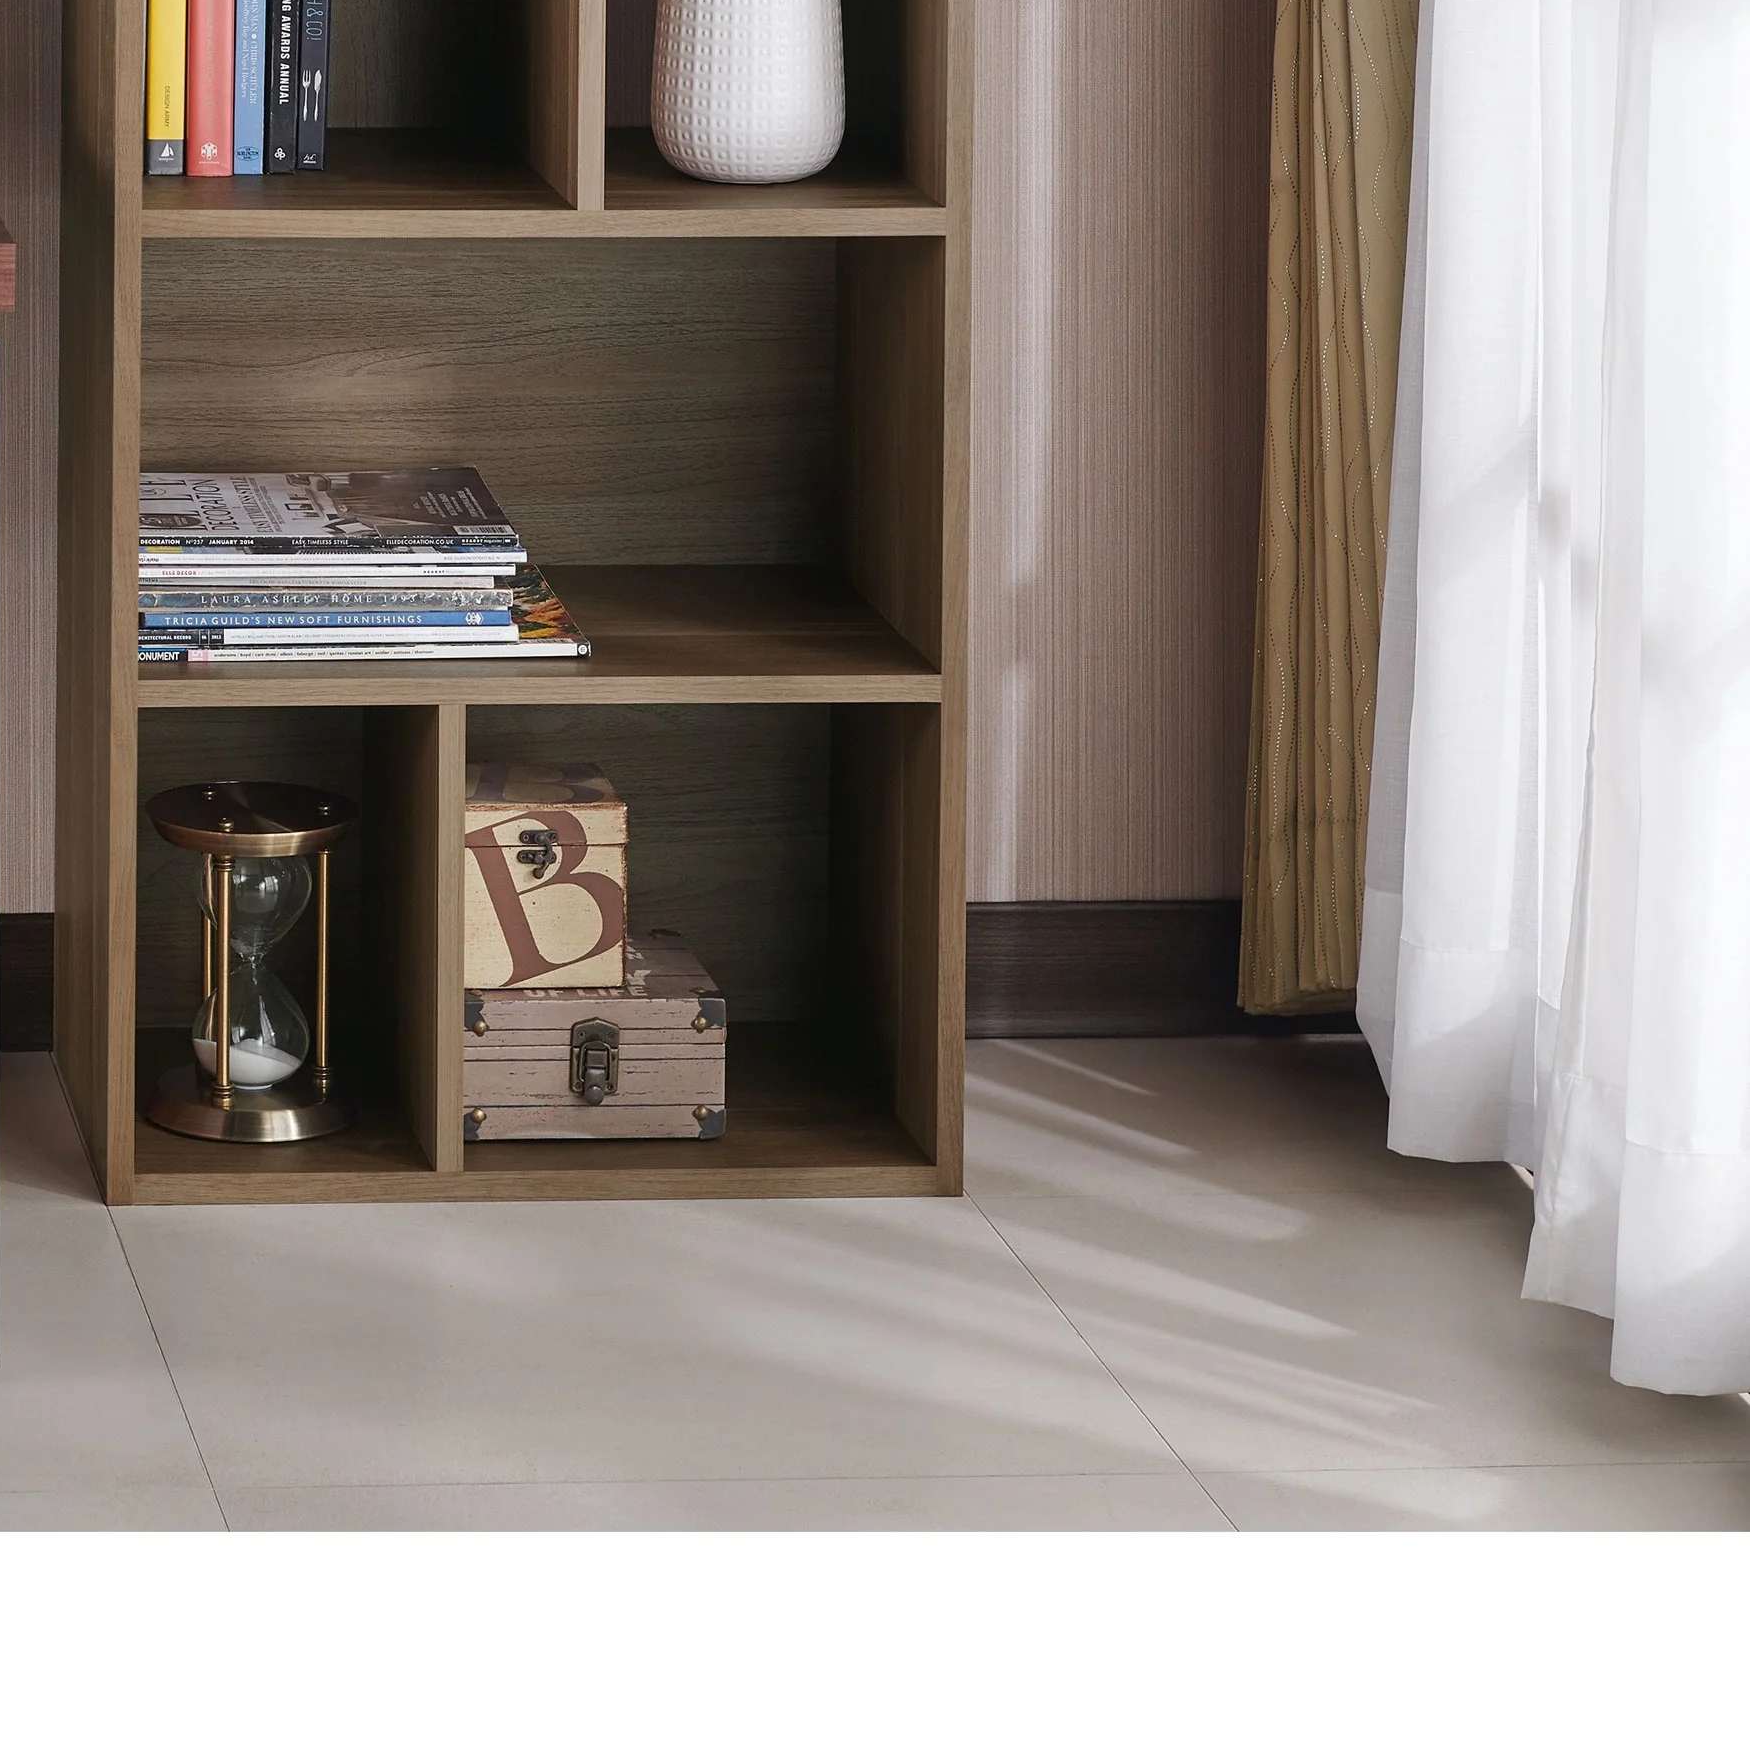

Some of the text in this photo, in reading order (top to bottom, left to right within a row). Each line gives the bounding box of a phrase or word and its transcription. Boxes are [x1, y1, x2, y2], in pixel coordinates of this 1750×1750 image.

[307, 8, 323, 17] &
[280, 16, 292, 60] AWARDS
[306, 20, 322, 41] CO!
[279, 63, 290, 105] ANNUAL
[189, 479, 240, 531] DECORATION
[201, 596, 251, 604] LAURA
[262, 595, 320, 604] ASHLEY
[331, 594, 373, 603] HOME
[164, 614, 422, 626] TRICIA GUILD'S NEW SOFT FURNISHINGS
[138, 652, 180, 661] ONUMENT
[465, 810, 623, 987] B
